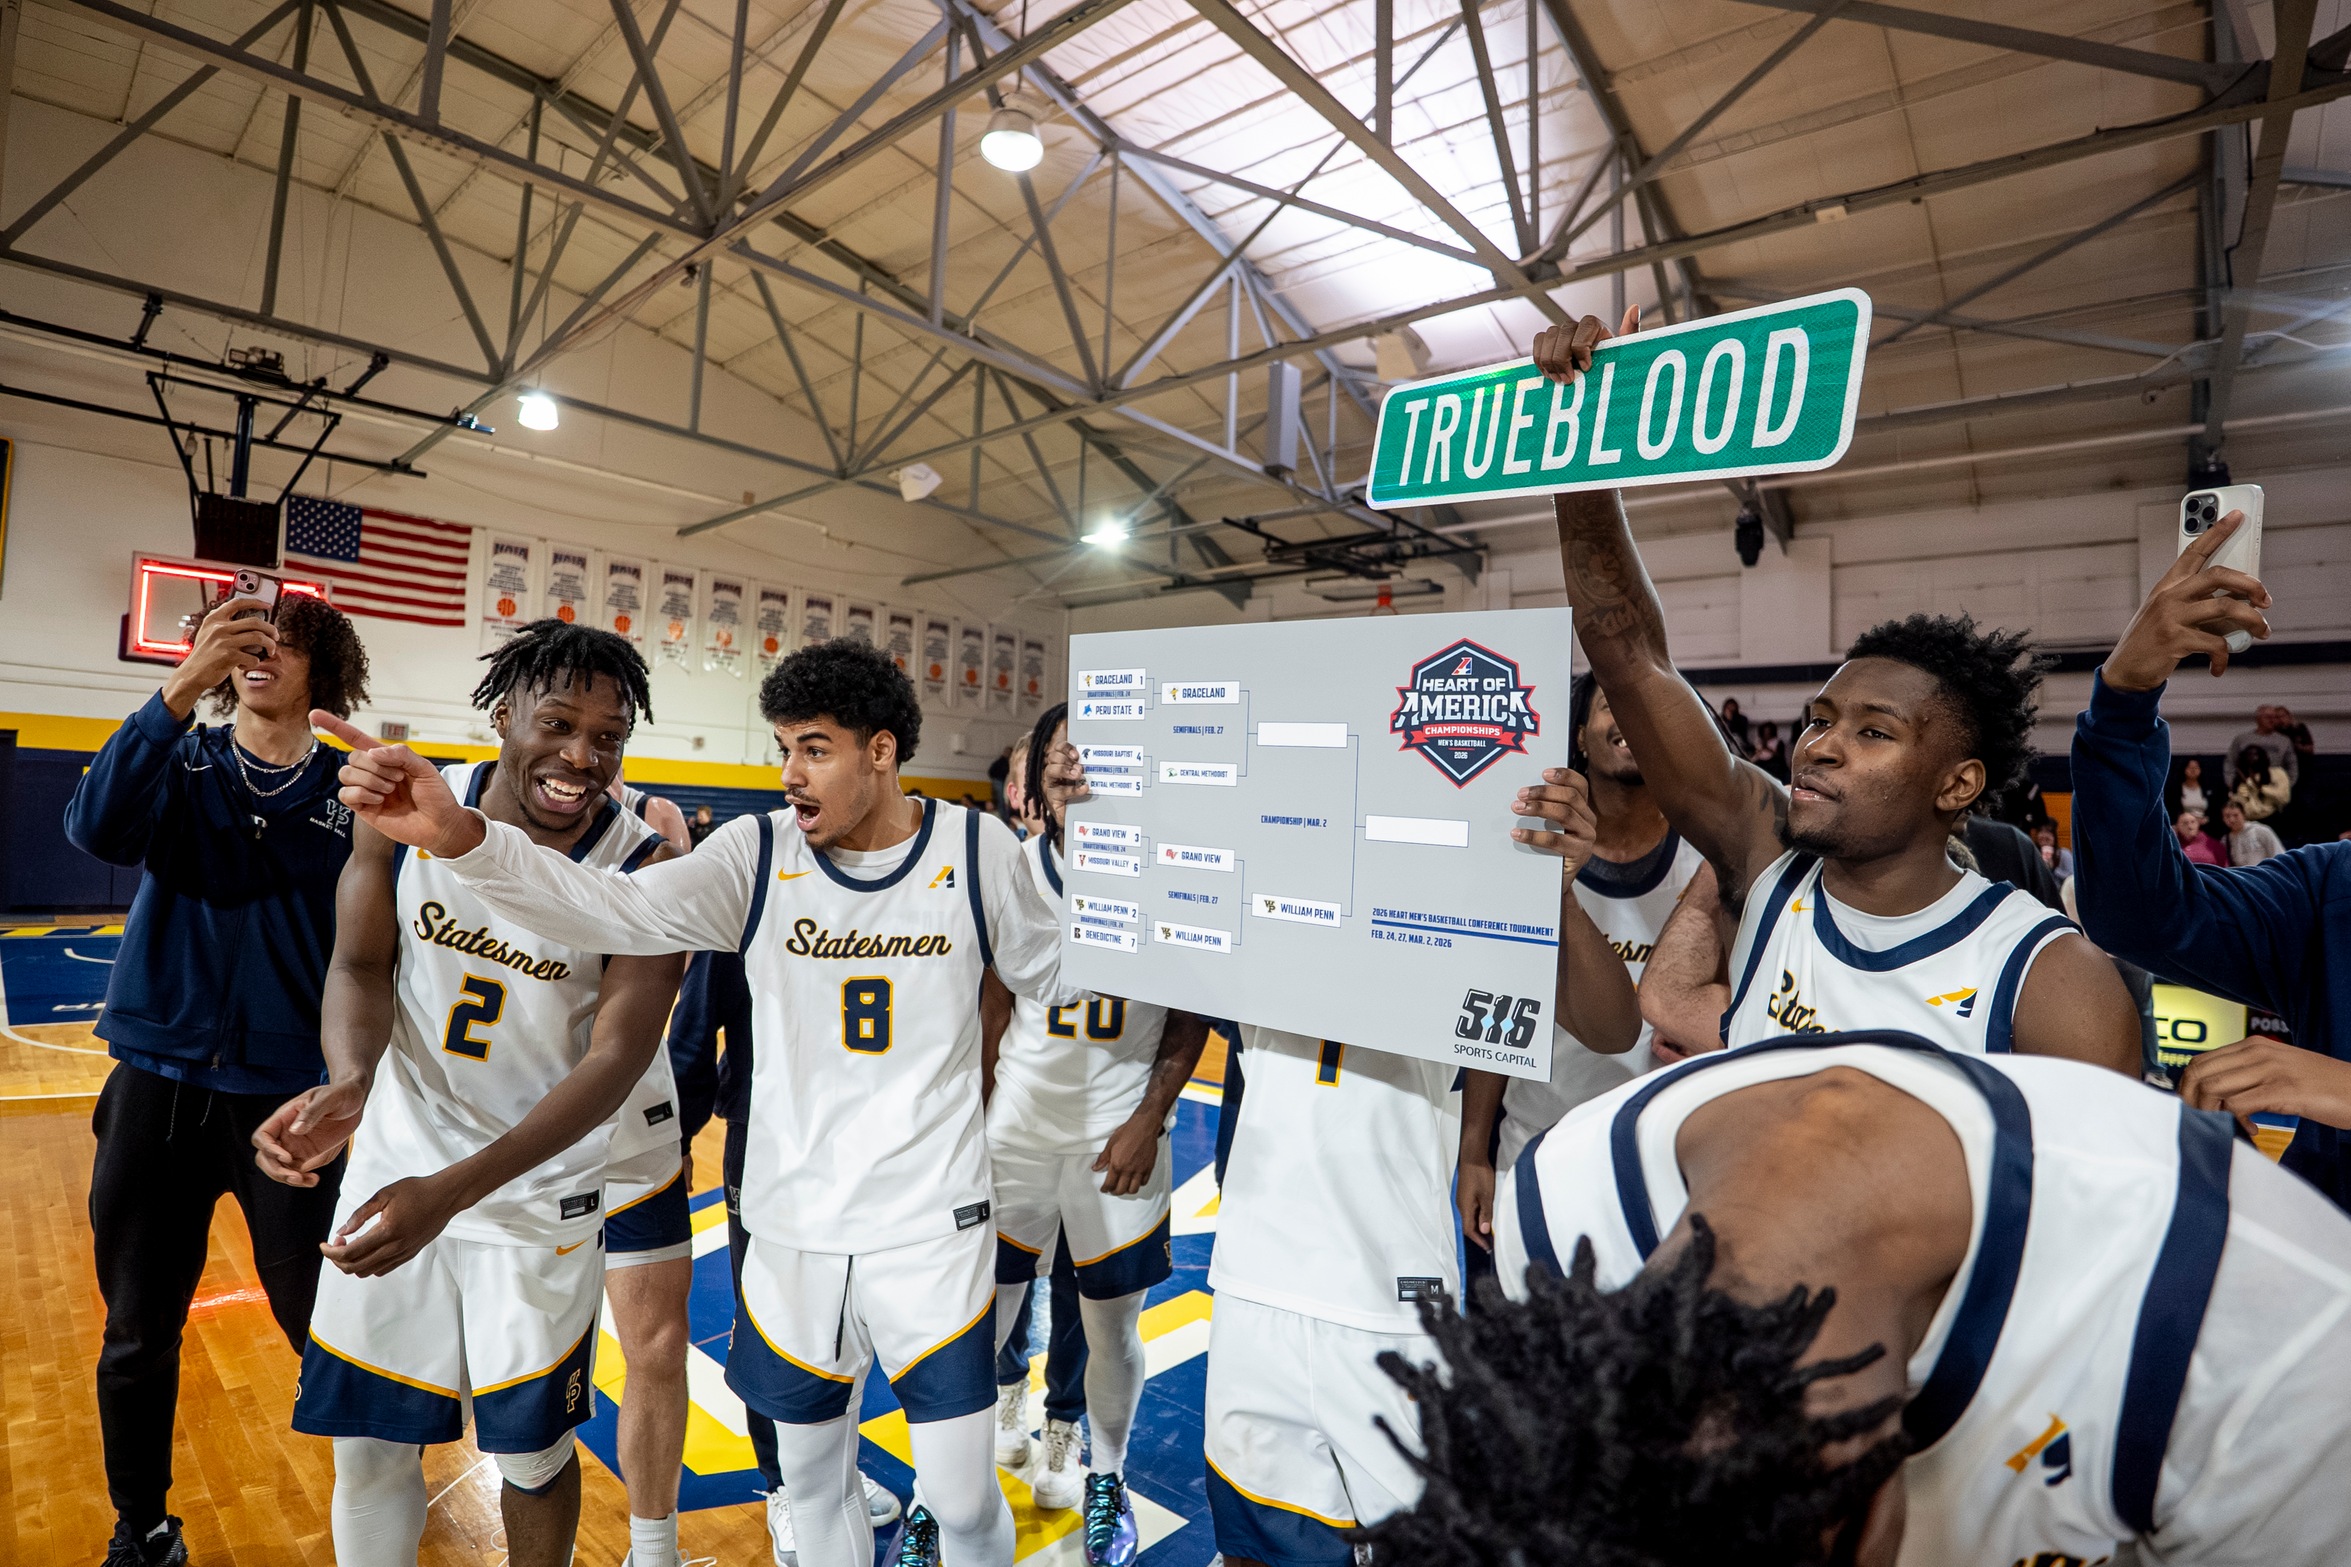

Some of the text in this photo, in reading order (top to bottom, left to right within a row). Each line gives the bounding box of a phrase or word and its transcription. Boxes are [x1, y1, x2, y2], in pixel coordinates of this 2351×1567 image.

[1399, 327, 1809, 487] TRUEBLOOD
[1095, 674, 1143, 685] GRACELAND 1
[1422, 678, 1506, 691] HEART OF
[1182, 688, 1226, 698] GRACELAND
[1095, 705, 1143, 714] PERU STATE 8
[1395, 691, 1534, 730] AMERICA
[1173, 726, 1224, 734] SEMIFINALS FEB. 27
[1425, 726, 1500, 736] CHAMPIONSHIPS
[1438, 739, 1486, 747] MEN'S BASKETBALL
[1136, 752, 1141, 761] 4
[1454, 752, 1468, 760] 2026
[1180, 769, 1200, 777] CENTRAL
[1136, 782, 1140, 790] 5
[1261, 815, 1327, 827] CHAMPIONSHIP MAR. 2
[1092, 828, 1110, 837] GRAND
[1112, 830, 1127, 839] VIEW
[1135, 833, 1139, 842] 3
[1181, 851, 1202, 862] GRAND
[1204, 853, 1221, 864] VIEW
[1088, 857, 1110, 865] MISSOURI
[1111, 859, 1129, 867] VALLEY
[1134, 863, 1138, 872] 6
[1168, 891, 1218, 904] SEMIFINALS FEB. 27
[1088, 902, 1112, 912] WILLIAM
[1113, 905, 1128, 915] PENN
[1132, 909, 1136, 918] 2
[1280, 903, 1312, 917] WILLIAM
[1314, 909, 1334, 920] PENN
[1372, 908, 1554, 937] 2026 HEART MEN'S BASKETBALL CONFERENCE TOURNAMENT
[414, 900, 571, 983] Statesmen
[785, 917, 952, 960] Statesmen
[1086, 930, 1122, 944] BENEDICTINE
[1131, 938, 1135, 947] 7
[1175, 930, 1203, 943] WILLIAM
[1204, 935, 1221, 946] PENN
[1371, 929, 1452, 948] FEB. 24, 27, MAR. 2, 2026
[442, 972, 508, 1063] 2
[840, 975, 894, 1056] 8
[1455, 988, 1541, 1049] 516
[1454, 1044, 1537, 1068] SPORTS CAPITAL
[591, 1198, 595, 1206] L
[982, 1207, 987, 1216] L
[1430, 1284, 1439, 1295] M
